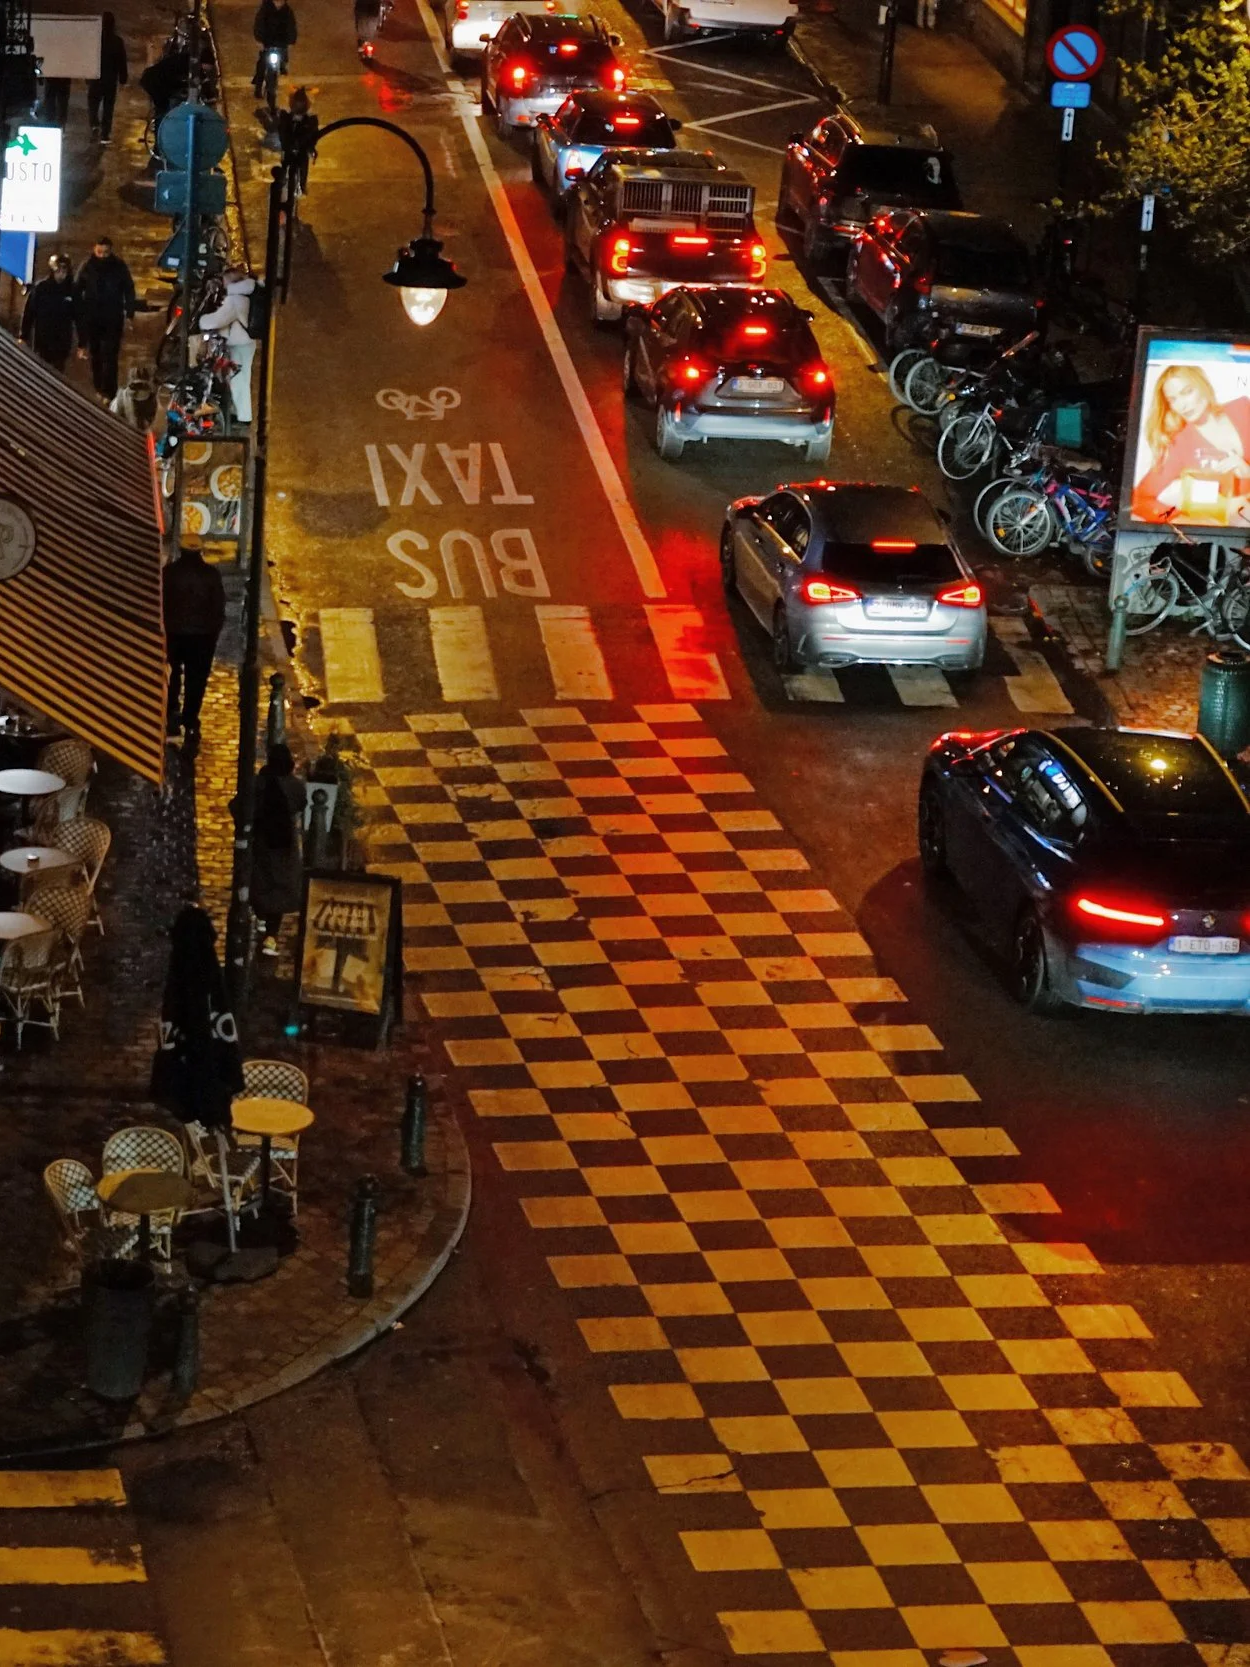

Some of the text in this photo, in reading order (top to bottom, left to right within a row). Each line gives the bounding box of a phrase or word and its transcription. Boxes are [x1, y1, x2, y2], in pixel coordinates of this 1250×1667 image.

[5, 162, 52, 182] USTO
[364, 443, 535, 507] TAXI
[386, 528, 551, 599] BUS
